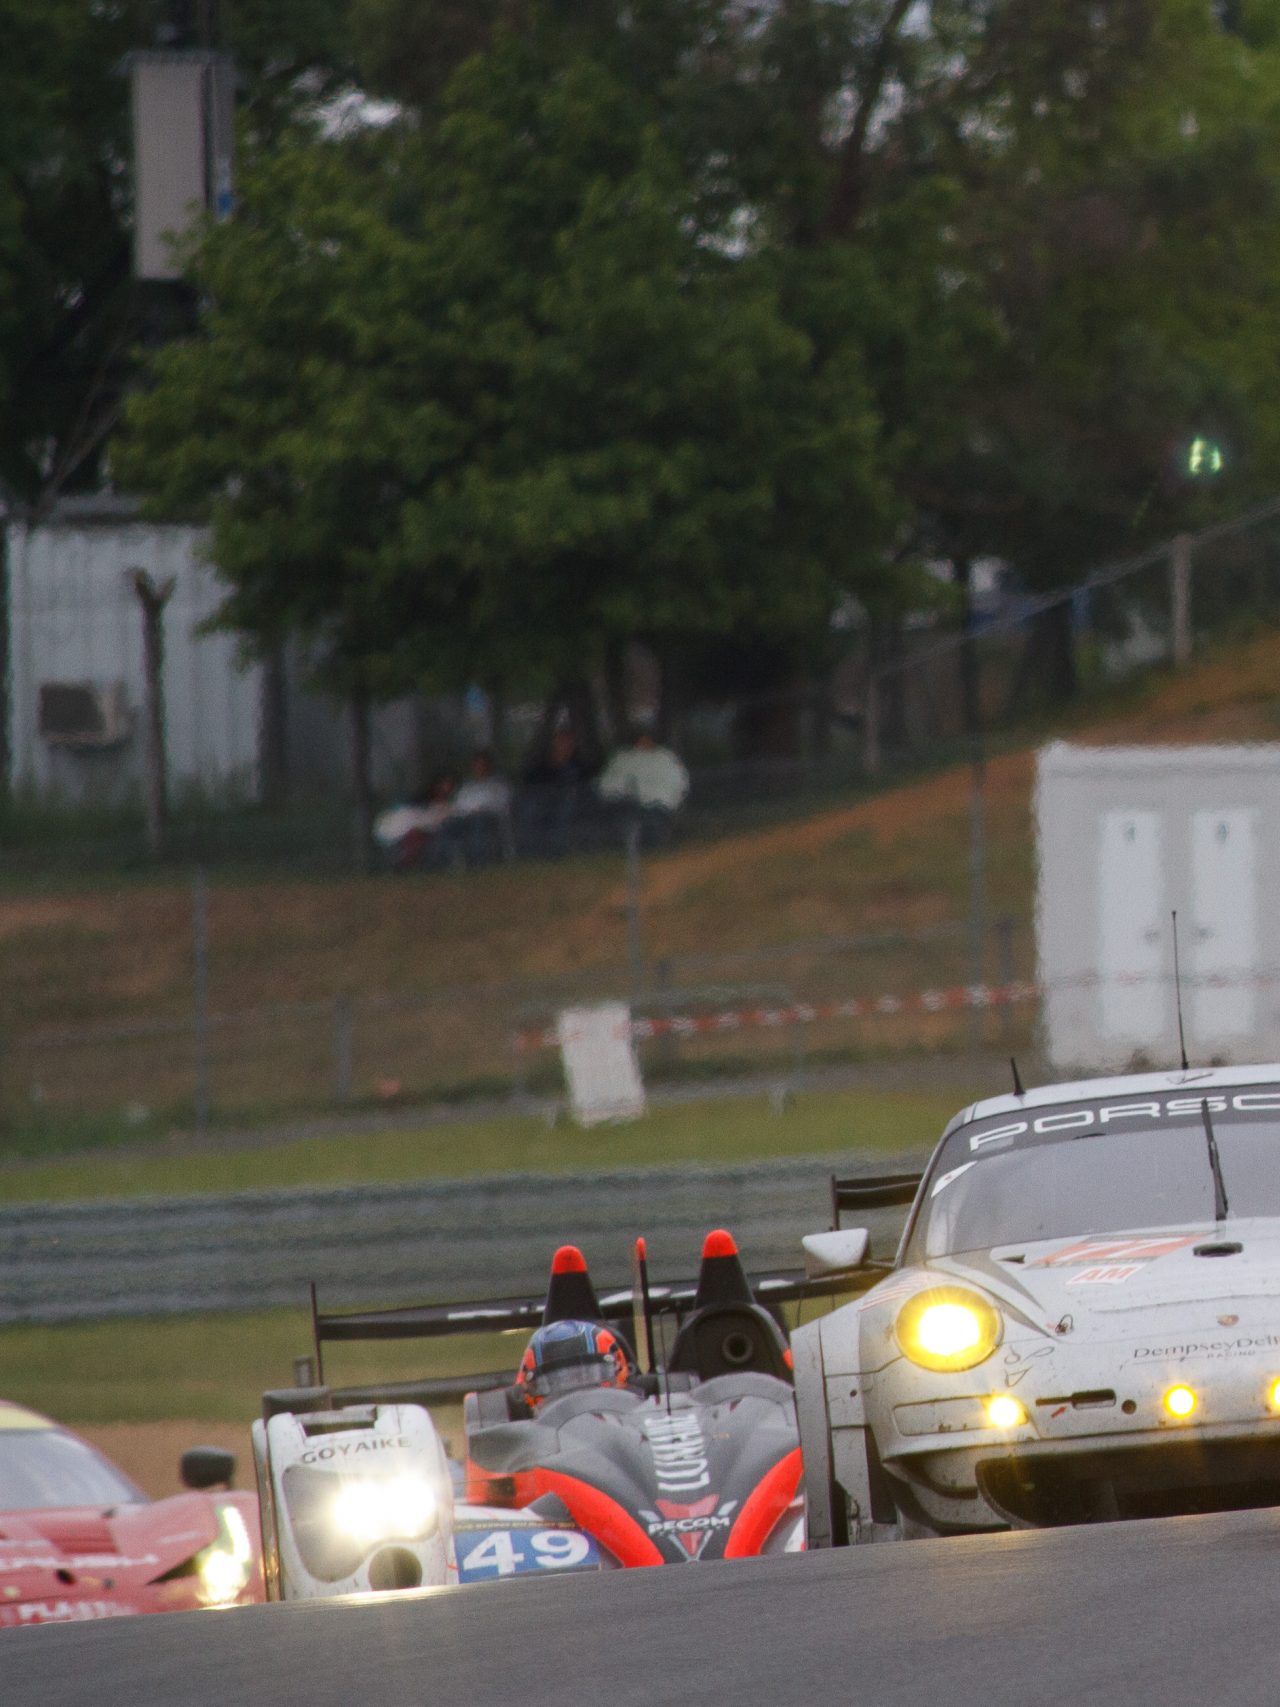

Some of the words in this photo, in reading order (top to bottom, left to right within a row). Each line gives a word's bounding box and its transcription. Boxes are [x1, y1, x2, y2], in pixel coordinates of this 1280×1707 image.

[1072, 1266, 1138, 1282] AM
[302, 1436, 411, 1465] GOYAIKE
[648, 1516, 731, 1534] PECOM
[462, 1529, 590, 1575] 49
